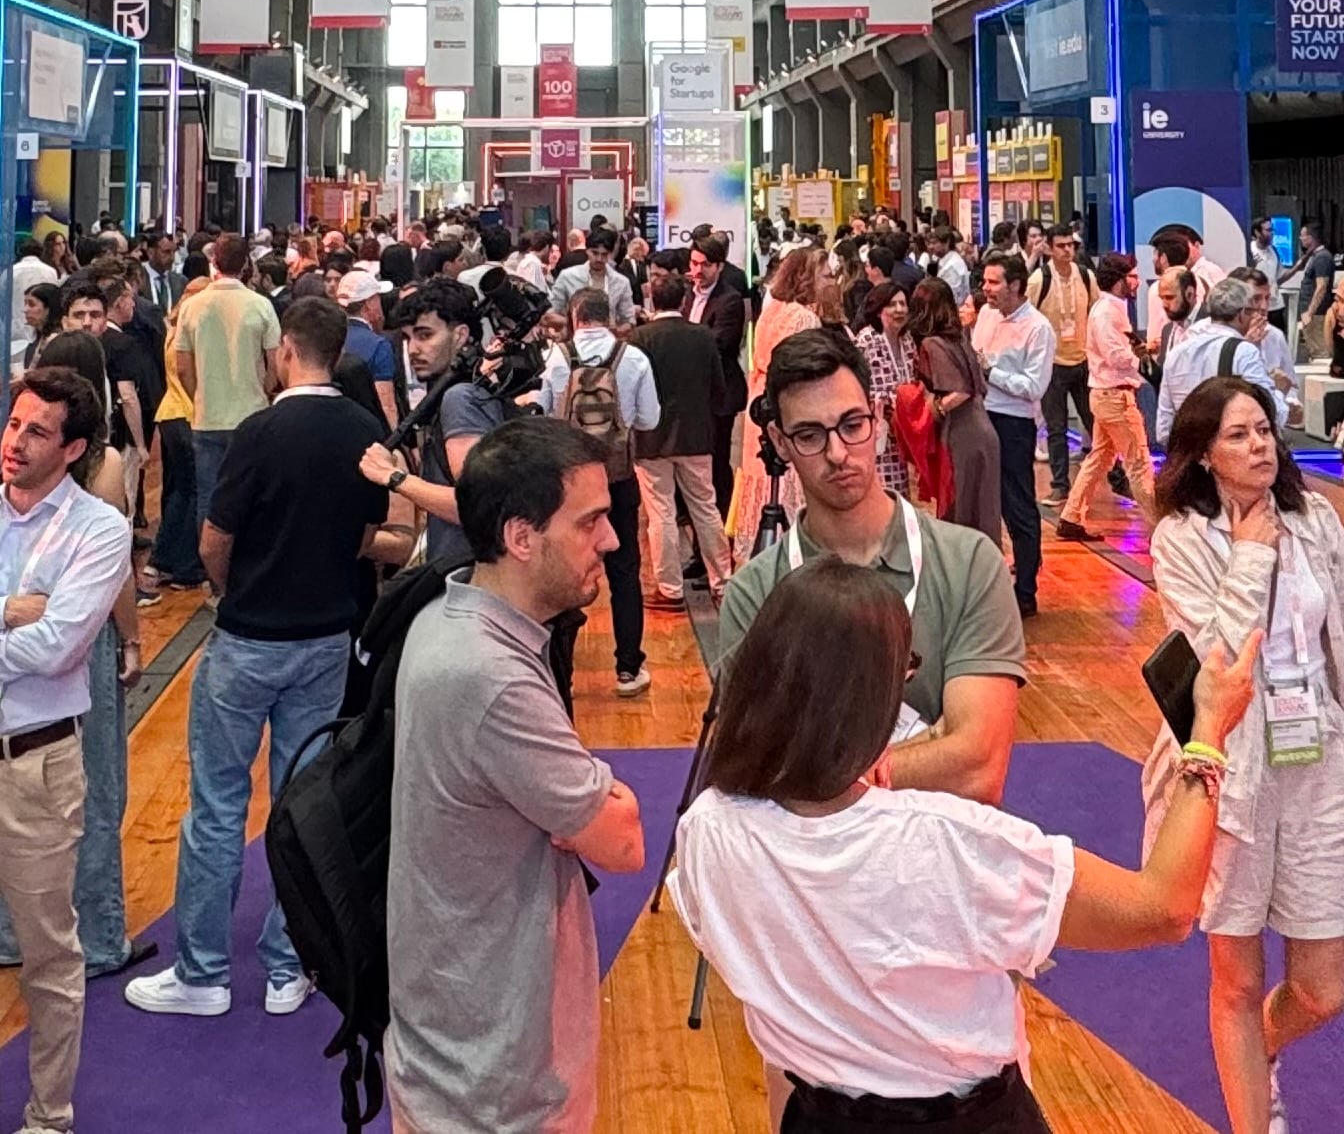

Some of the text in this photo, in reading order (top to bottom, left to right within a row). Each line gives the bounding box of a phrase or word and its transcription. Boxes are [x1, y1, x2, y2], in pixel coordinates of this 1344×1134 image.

[1292, 46, 1339, 60] NOW
[669, 62, 711, 76] Google
[543, 80, 573, 94] 100
[670, 76, 685, 86] for
[669, 89, 714, 100] Startups
[1100, 104, 1109, 116] 3
[1142, 102, 1169, 129] ie
[592, 199, 620, 209] cinfa
